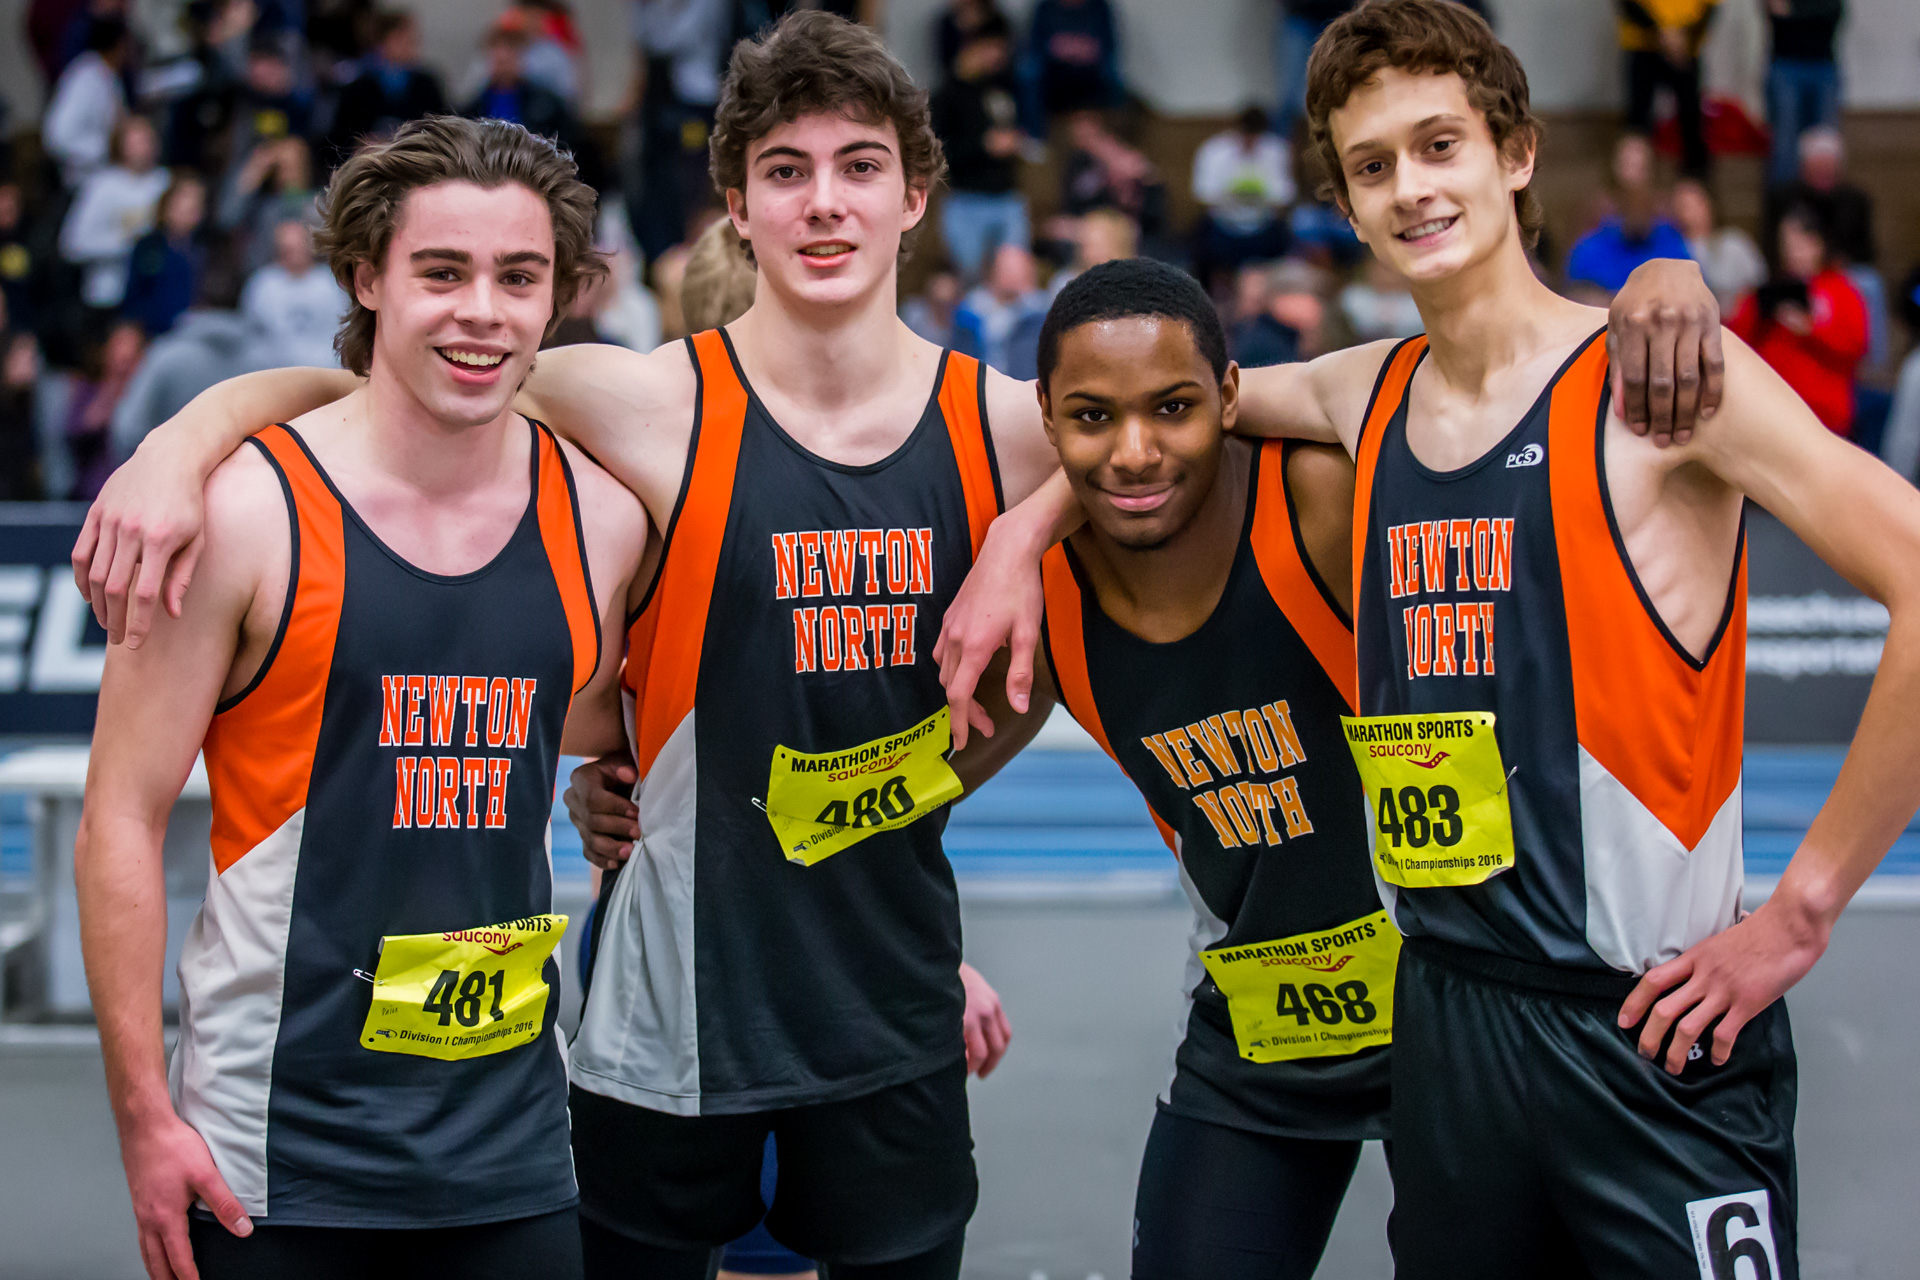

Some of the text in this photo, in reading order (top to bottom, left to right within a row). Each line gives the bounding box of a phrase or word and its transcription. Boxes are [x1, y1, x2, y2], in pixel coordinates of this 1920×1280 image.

[1505, 450, 1536, 468] PCS
[772, 528, 933, 600] NEWTON
[1388, 518, 1515, 599] NEWTON
[793, 604, 917, 674] NORTH
[379, 675, 537, 749] NEWTON
[1346, 719, 1474, 742] MARATHON SPORTS
[791, 719, 936, 773] MARATHON SPORTS
[827, 752, 897, 783] saucony
[1141, 699, 1307, 790] NEWTON
[1369, 743, 1432, 759] saucony
[392, 756, 511, 829] NORTH
[815, 775, 915, 829] 480
[1378, 785, 1463, 848] 483
[1405, 857, 1475, 871] Championships
[1478, 854, 1502, 867] 2016
[442, 930, 512, 948] saucony
[1219, 922, 1376, 964] MARATHON SPORTS
[1261, 953, 1333, 967] saucony
[422, 969, 505, 1027] 481
[1276, 980, 1377, 1026] 468
[400, 1030, 442, 1045] Division
[451, 1024, 512, 1047] Championships
[514, 1021, 533, 1033] 2016
[1272, 1035, 1312, 1046] Division
[1706, 1202, 1773, 1280] 6
